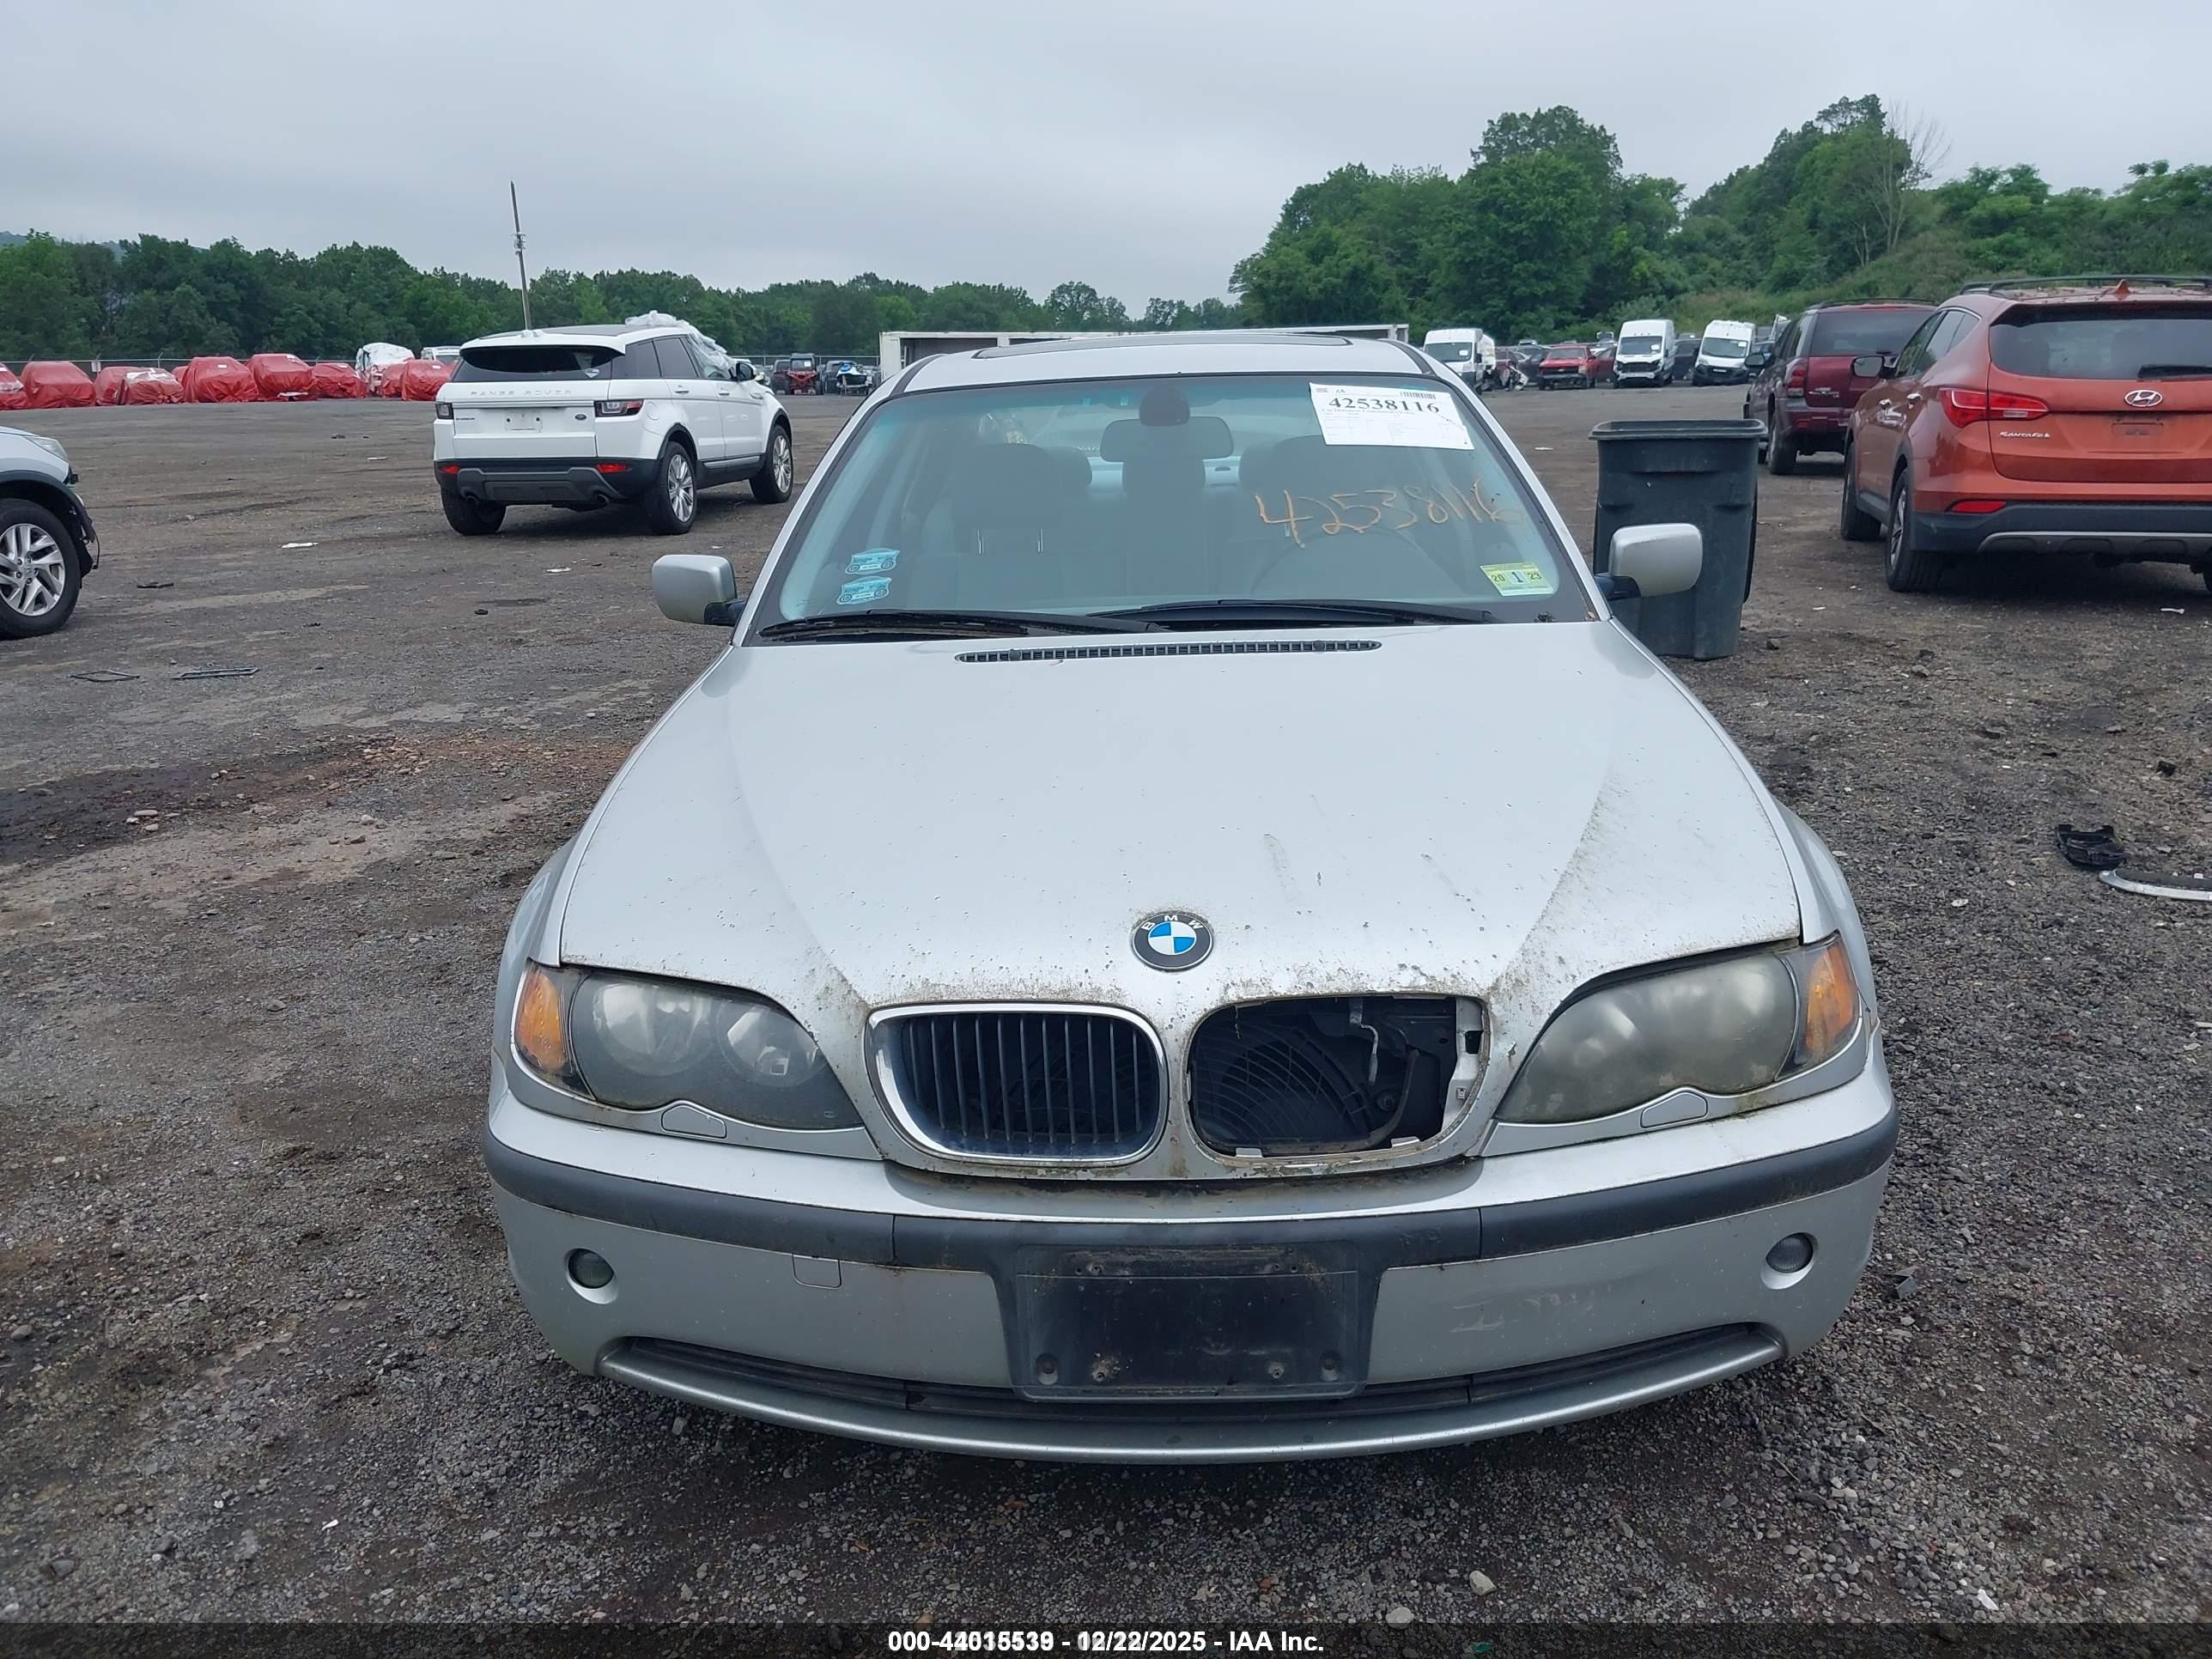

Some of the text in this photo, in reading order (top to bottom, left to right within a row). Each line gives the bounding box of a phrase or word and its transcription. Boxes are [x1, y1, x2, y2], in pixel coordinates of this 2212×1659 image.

[1328, 397, 1440, 414] 42538116
[1510, 571, 1524, 583] 1
[1139, 915, 1204, 931] BMW
